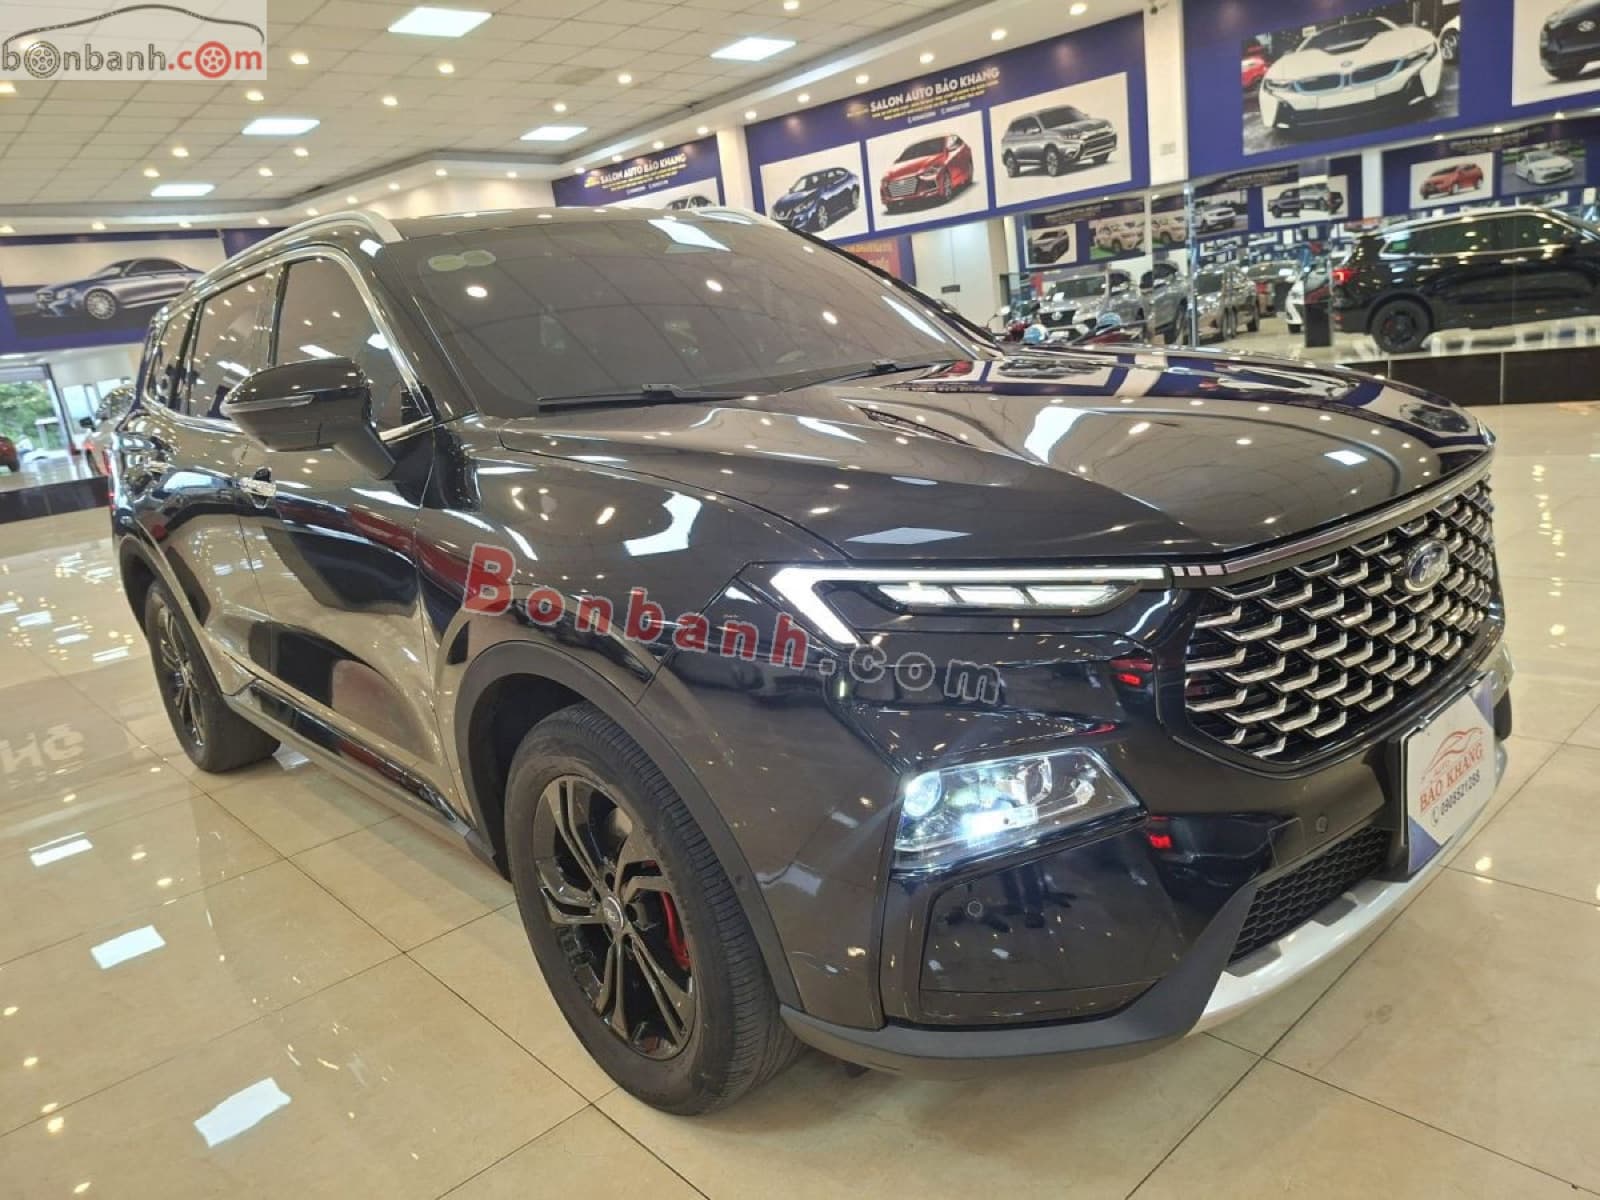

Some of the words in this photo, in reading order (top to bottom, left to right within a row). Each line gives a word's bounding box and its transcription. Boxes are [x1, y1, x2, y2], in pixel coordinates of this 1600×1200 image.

[870, 94, 904, 112] SALON
[904, 85, 934, 103] AUTO
[959, 66, 1000, 88] KHANG
[600, 171, 623, 185] SALON
[623, 164, 642, 178] AUTO
[1446, 741, 1484, 788] KHANG
